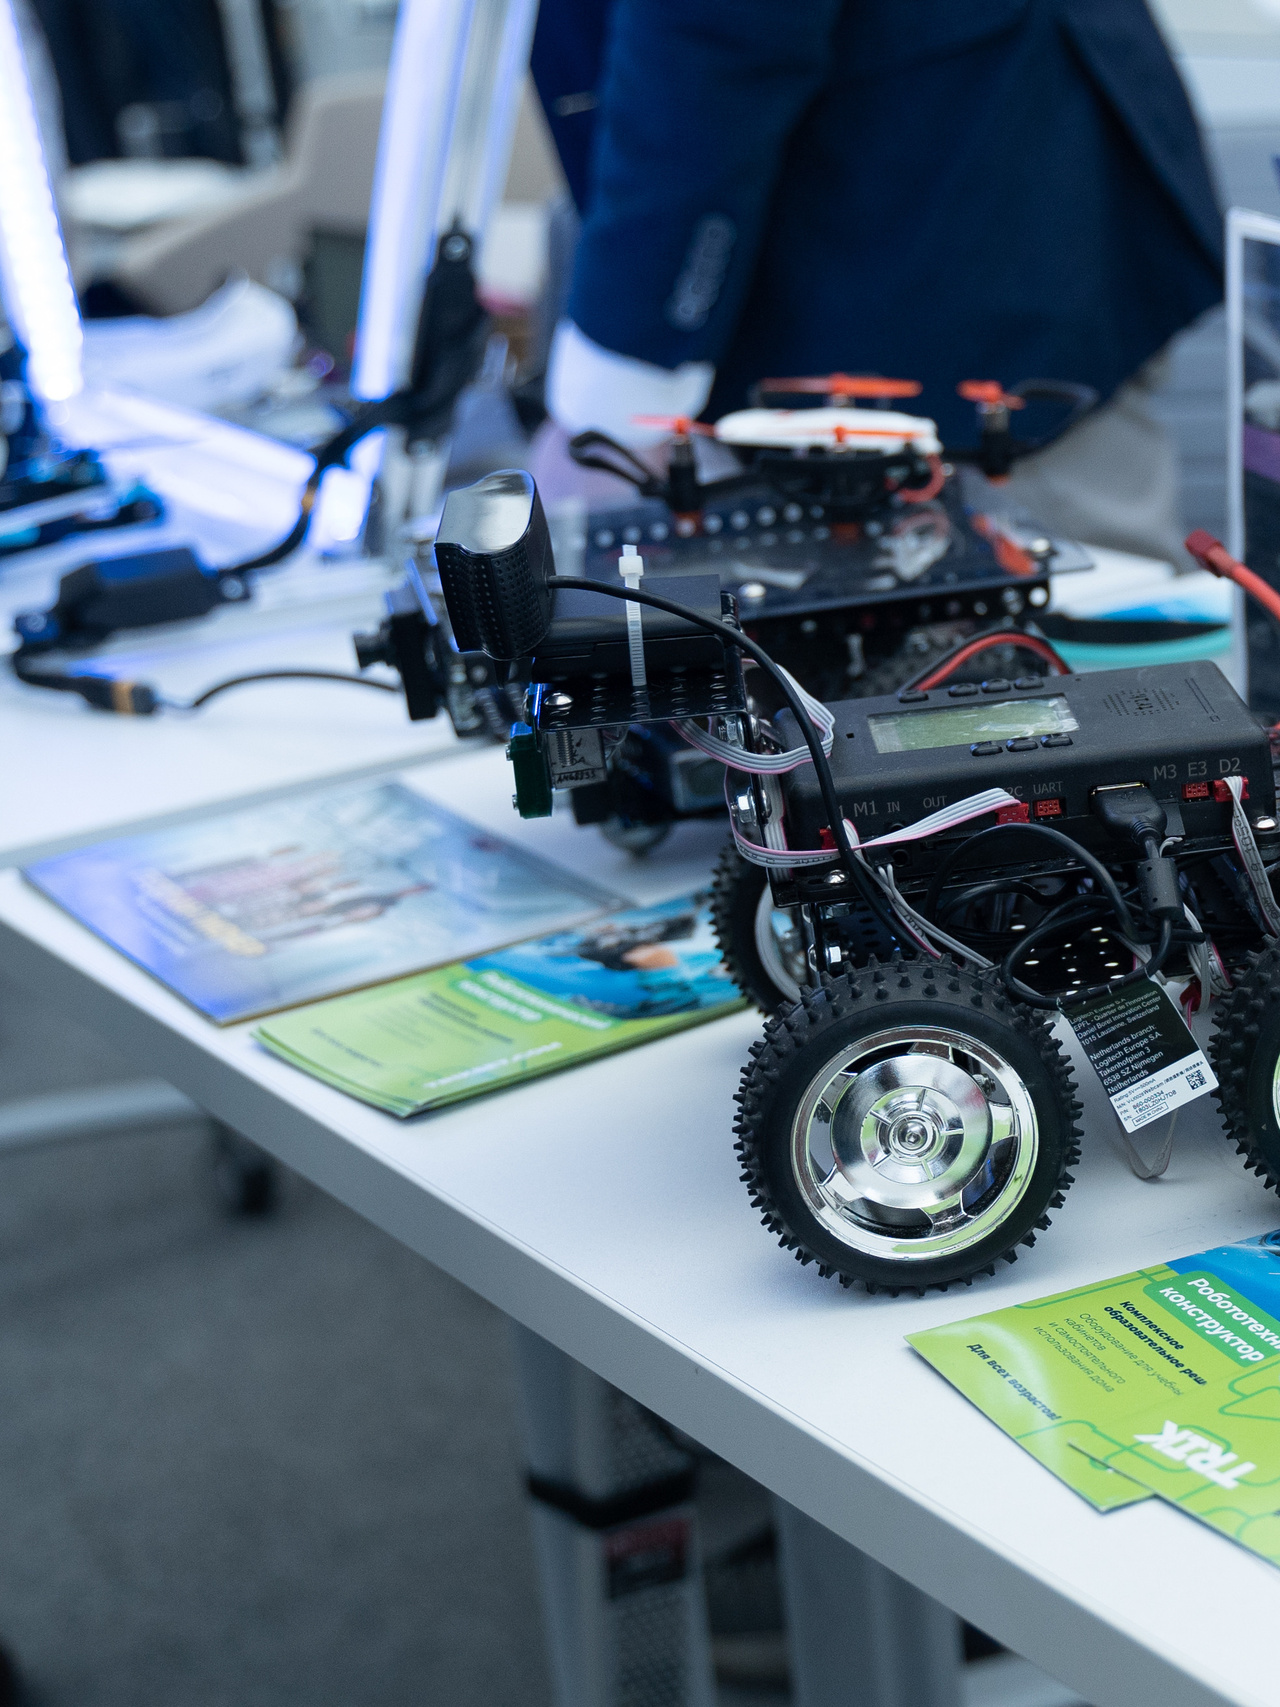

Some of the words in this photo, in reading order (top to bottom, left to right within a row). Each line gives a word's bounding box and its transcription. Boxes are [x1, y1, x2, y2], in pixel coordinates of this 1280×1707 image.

[854, 801, 879, 818] M1
[887, 801, 900, 813] IN
[923, 796, 947, 809] OUT
[1033, 781, 1063, 795] UART
[1153, 764, 1177, 780] M3
[1188, 761, 1207, 777] E3
[1219, 757, 1242, 774] D2
[1073, 1020, 1091, 1032] EPFL
[1077, 1025, 1098, 1039] Daniel
[1096, 1017, 1113, 1029] Borel
[1112, 1004, 1143, 1021] Innovation
[1141, 995, 1161, 1008] Center
[1081, 1034, 1098, 1046] 1015
[1126, 1004, 1160, 1024] Switzerland
[1090, 1036, 1131, 1061] Netherlands
[1130, 1024, 1157, 1040] branch:
[1094, 1050, 1124, 1070] Logitech
[1123, 1038, 1149, 1054] Europe
[1098, 1050, 1145, 1077] Takenhofplein
[1103, 1072, 1120, 1086] 6538
[1120, 1066, 1132, 1077] SZ
[1131, 1051, 1164, 1071] Nijmegen
[1107, 1069, 1149, 1094] Netherlands
[1064, 1317, 1107, 1351] кабинетов
[1079, 1312, 1138, 1360] Оборудование
[1133, 1359, 1154, 1372] для
[1103, 1306, 1184, 1369] образовательное
[1180, 1367, 1208, 1386] реш
[1119, 1300, 1184, 1350] Комплексное
[1159, 1286, 1265, 1363] конструктор
[1033, 1325, 1095, 1378] использования
[1089, 1373, 1115, 1393] дома
[1056, 1324, 1126, 1385] самостоятельного
[966, 1343, 991, 1361] Для
[986, 1359, 1012, 1379] всех
[1008, 1378, 1062, 1421] возрастов!
[1133, 1419, 1257, 1490] TRIK
